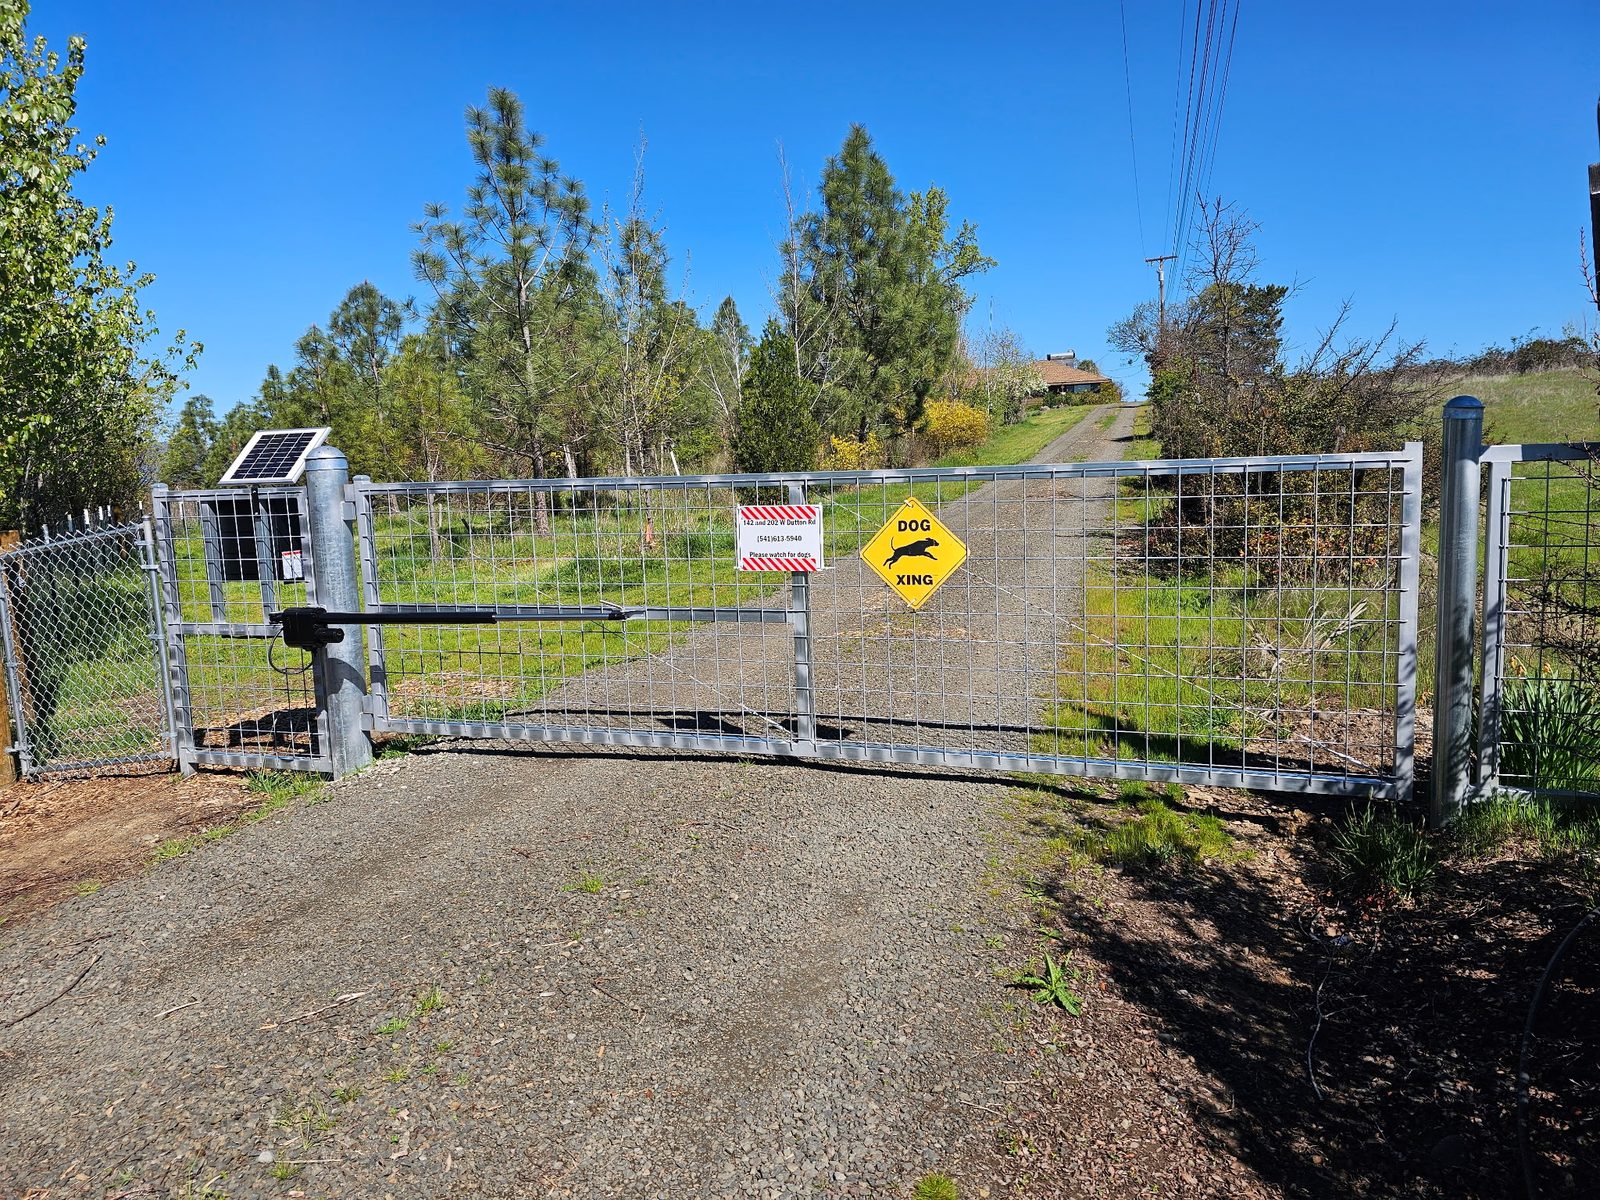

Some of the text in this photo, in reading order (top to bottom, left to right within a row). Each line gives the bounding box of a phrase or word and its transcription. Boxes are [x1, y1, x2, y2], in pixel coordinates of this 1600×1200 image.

[897, 519, 931, 532] DOG
[757, 535, 802, 543] (541)613-5940
[896, 574, 934, 586] XING
